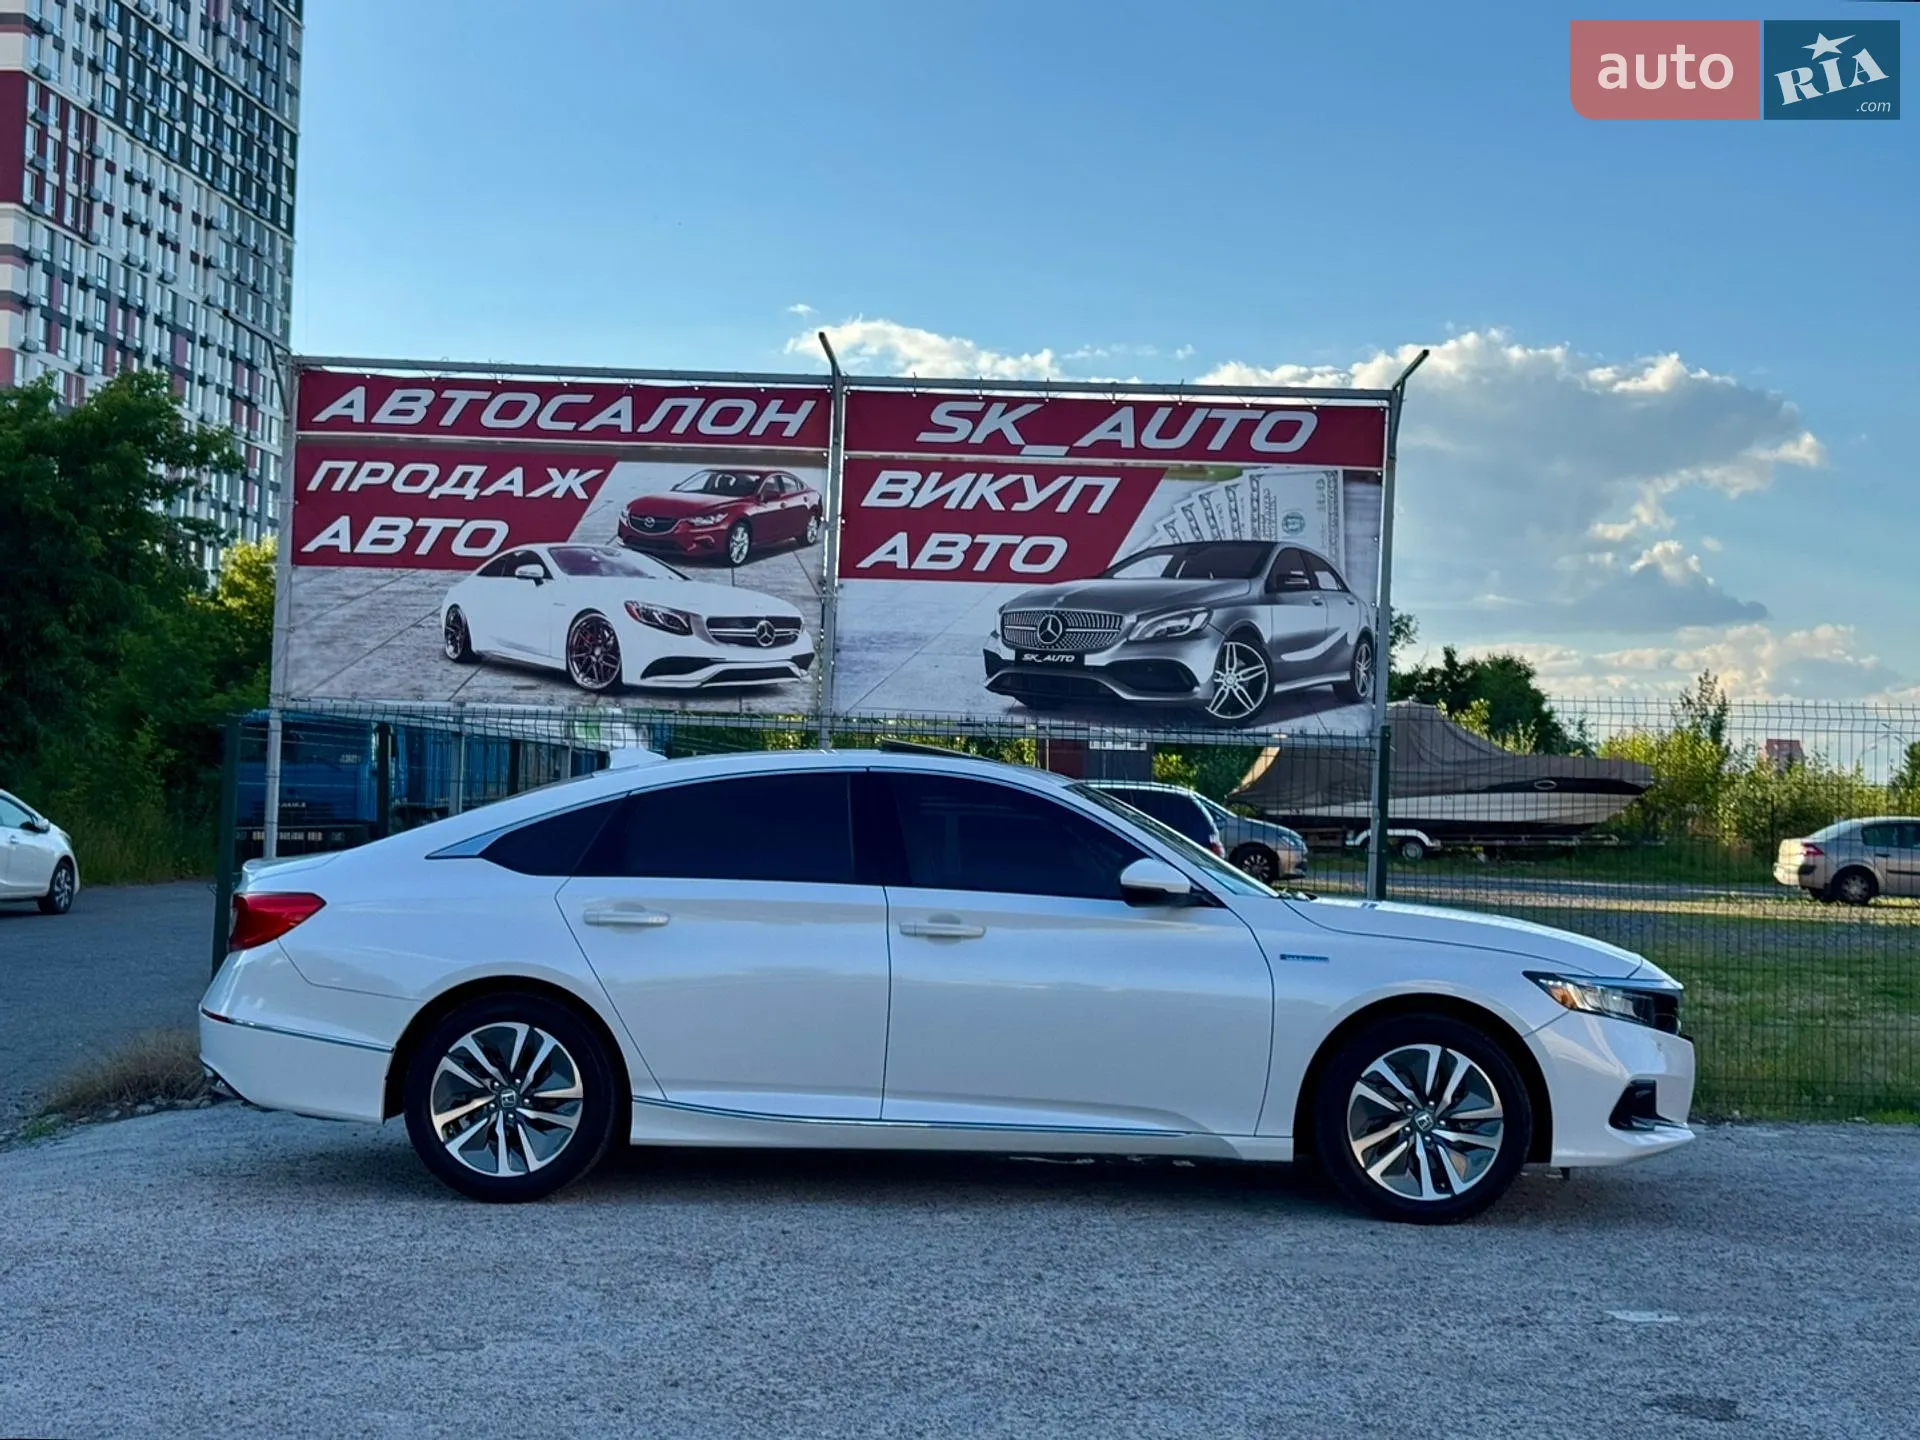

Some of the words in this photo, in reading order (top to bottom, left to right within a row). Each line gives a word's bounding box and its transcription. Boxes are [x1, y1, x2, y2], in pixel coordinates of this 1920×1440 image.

[312, 386, 814, 438] АВТОСАЛОН
[916, 401, 1318, 457] SK_AUTO
[306, 460, 603, 500] ПРОДАЖ
[860, 470, 1121, 513] ВИКУП
[301, 515, 510, 557] АВТО
[857, 532, 1067, 573] АВТО
[1022, 653, 1075, 662] SK_AUTO
